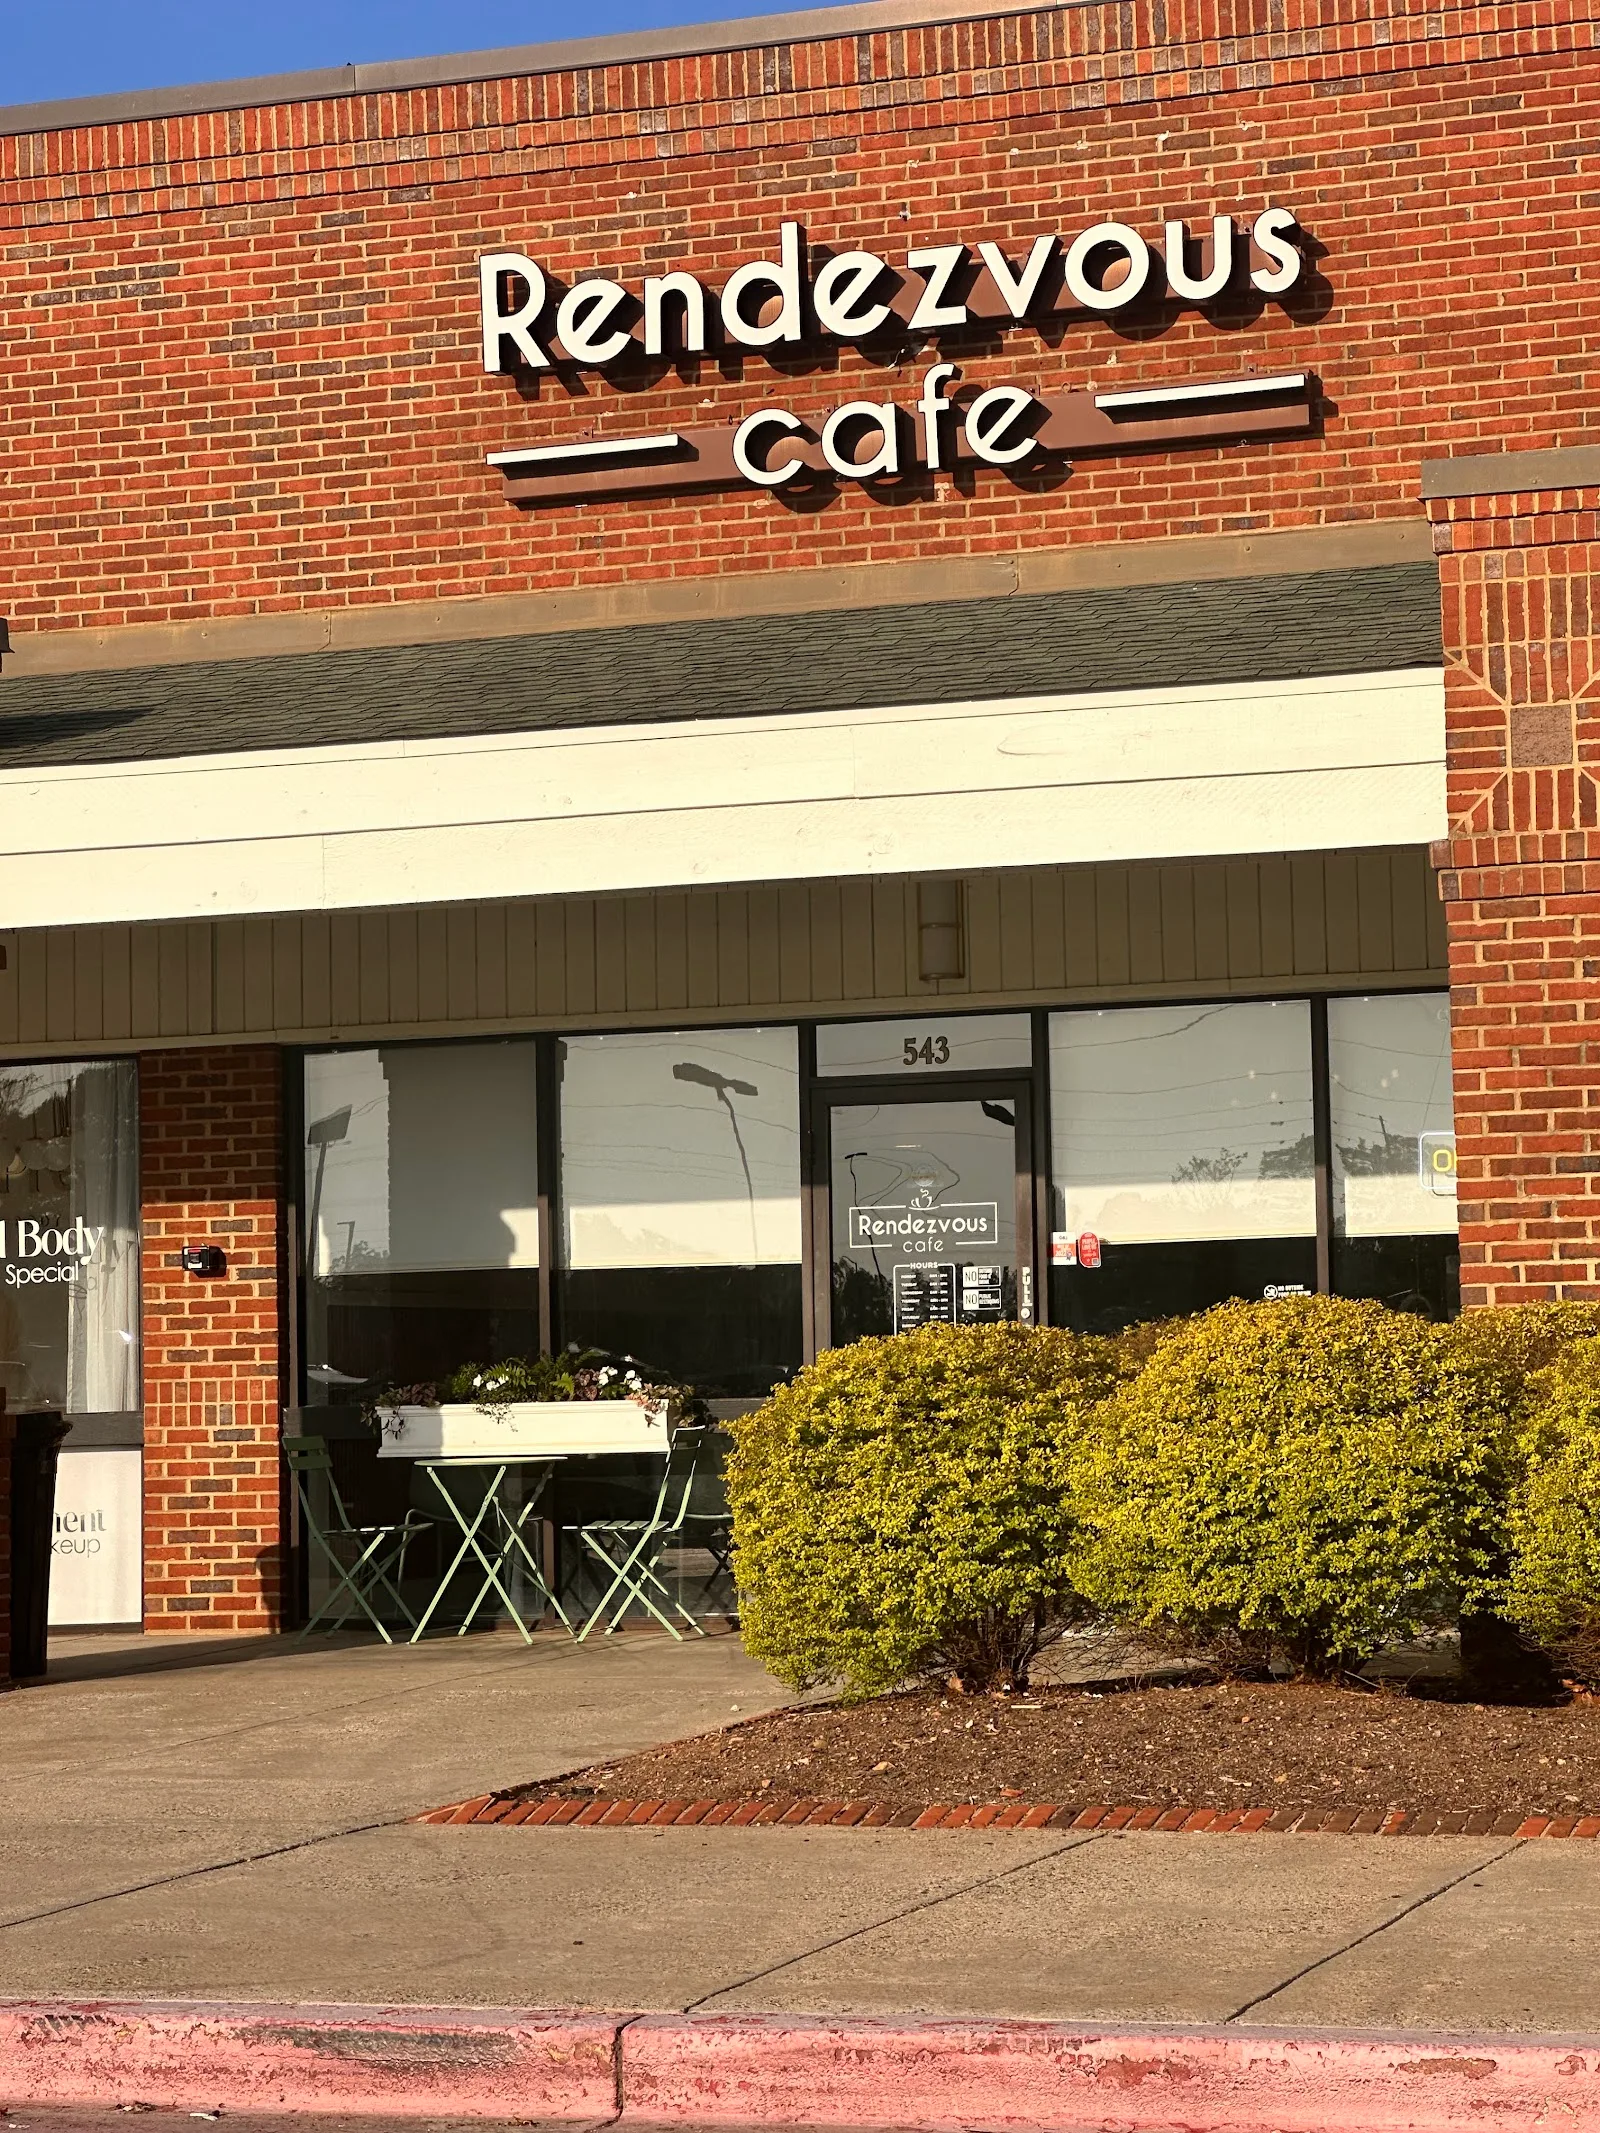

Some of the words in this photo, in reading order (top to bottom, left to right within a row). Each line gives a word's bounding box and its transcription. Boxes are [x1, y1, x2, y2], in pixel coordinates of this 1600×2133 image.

[479, 207, 1304, 373] Rendezvous
[732, 363, 1038, 485] cafe
[903, 1036, 950, 1065] 543
[858, 1213, 988, 1236] Rendezvous
[18, 1215, 104, 1265] Body
[902, 1236, 944, 1253] cafe
[5, 1260, 79, 1289] Special
[965, 1271, 977, 1282] NO
[1022, 1266, 1031, 1304] PULL
[965, 1294, 978, 1305] NO
